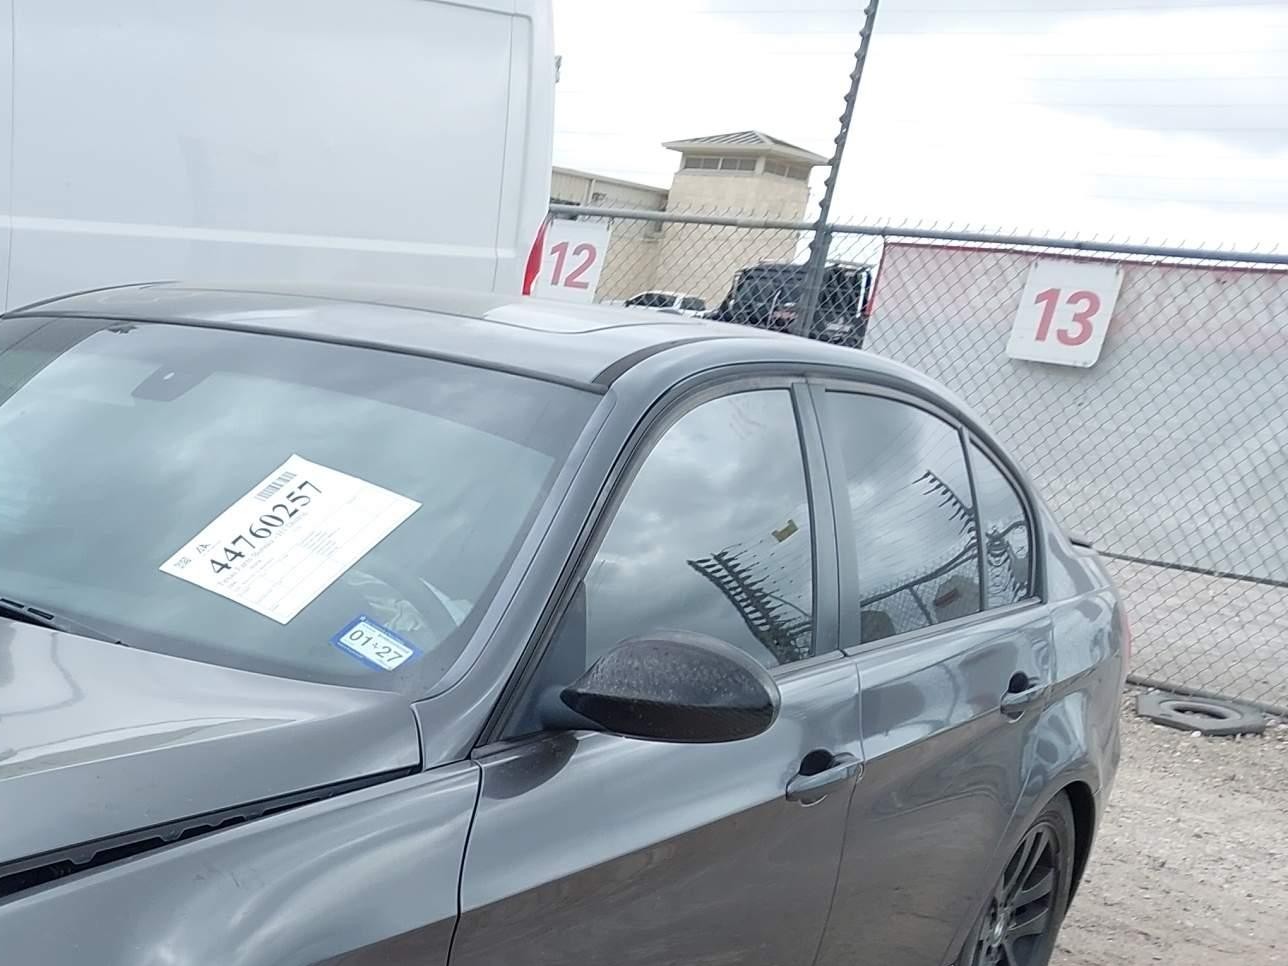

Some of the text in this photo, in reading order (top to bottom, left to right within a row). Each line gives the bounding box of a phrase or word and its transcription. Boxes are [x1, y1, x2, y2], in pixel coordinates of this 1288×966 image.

[550, 242, 597, 289] 12
[1034, 288, 1101, 346] 13
[210, 480, 323, 575] 44760257
[349, 629, 373, 646] 01
[375, 646, 403, 662] 27
